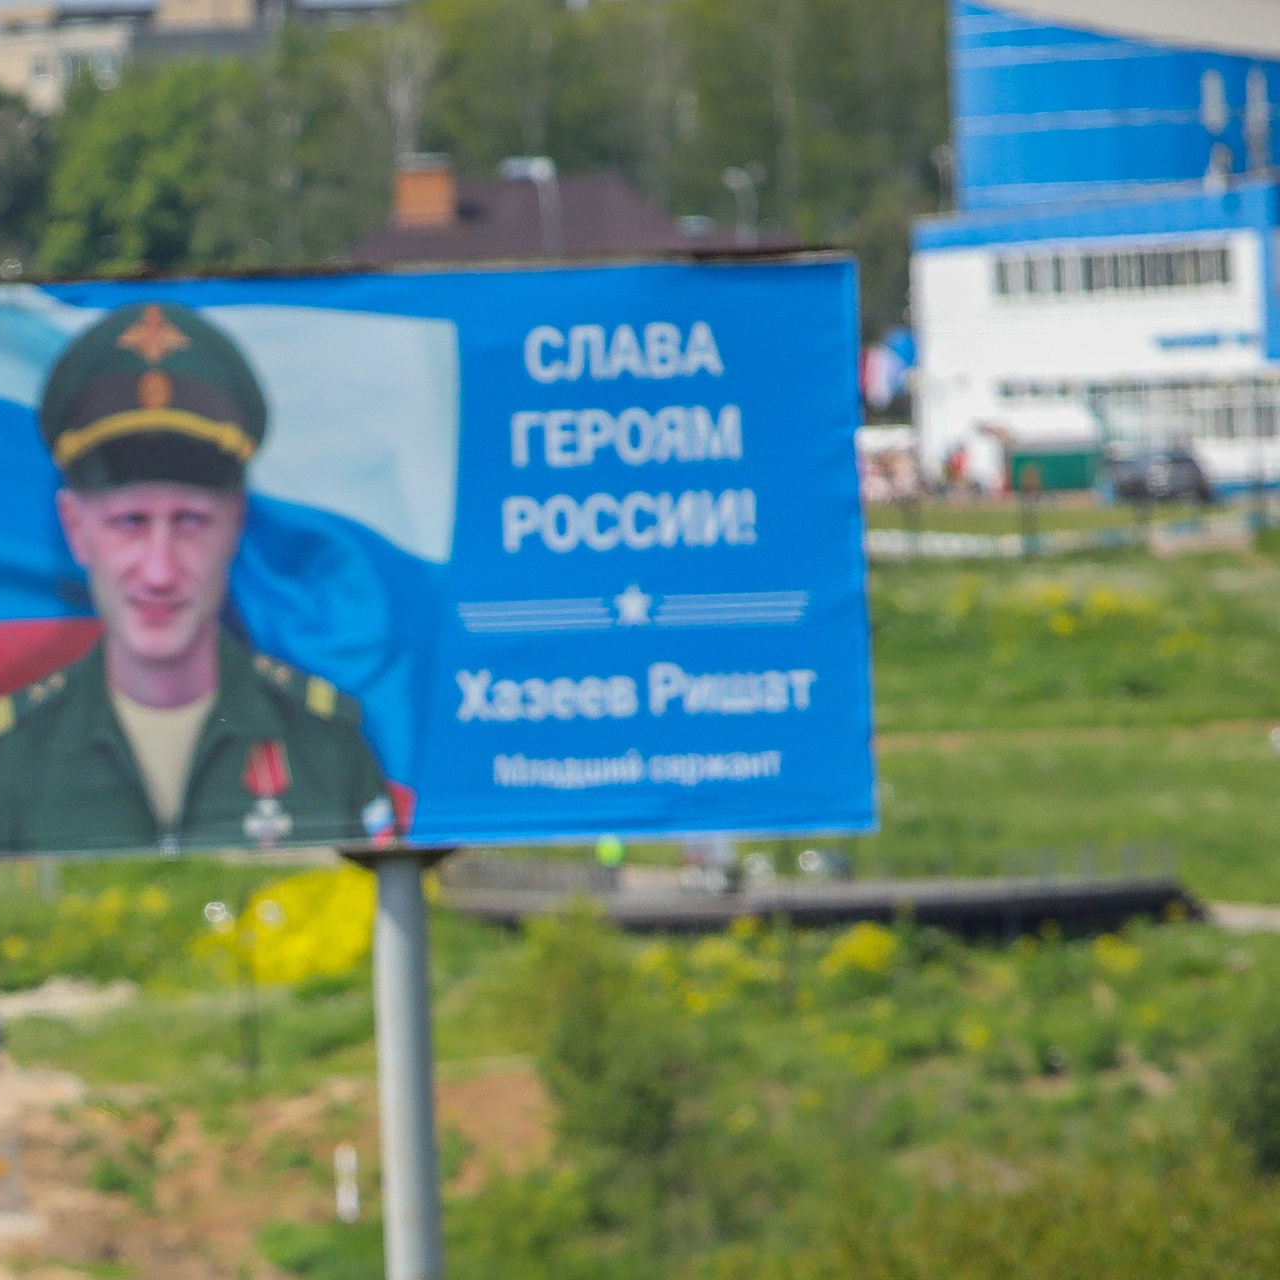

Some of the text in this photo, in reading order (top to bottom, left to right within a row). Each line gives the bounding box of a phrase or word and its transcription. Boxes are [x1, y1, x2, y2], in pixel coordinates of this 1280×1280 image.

[524, 321, 724, 383] СЛАВА
[511, 404, 743, 468] ГЕРОЯМ
[502, 488, 757, 554] РОССИИ!
[455, 661, 817, 722] Хазеев Ришат
